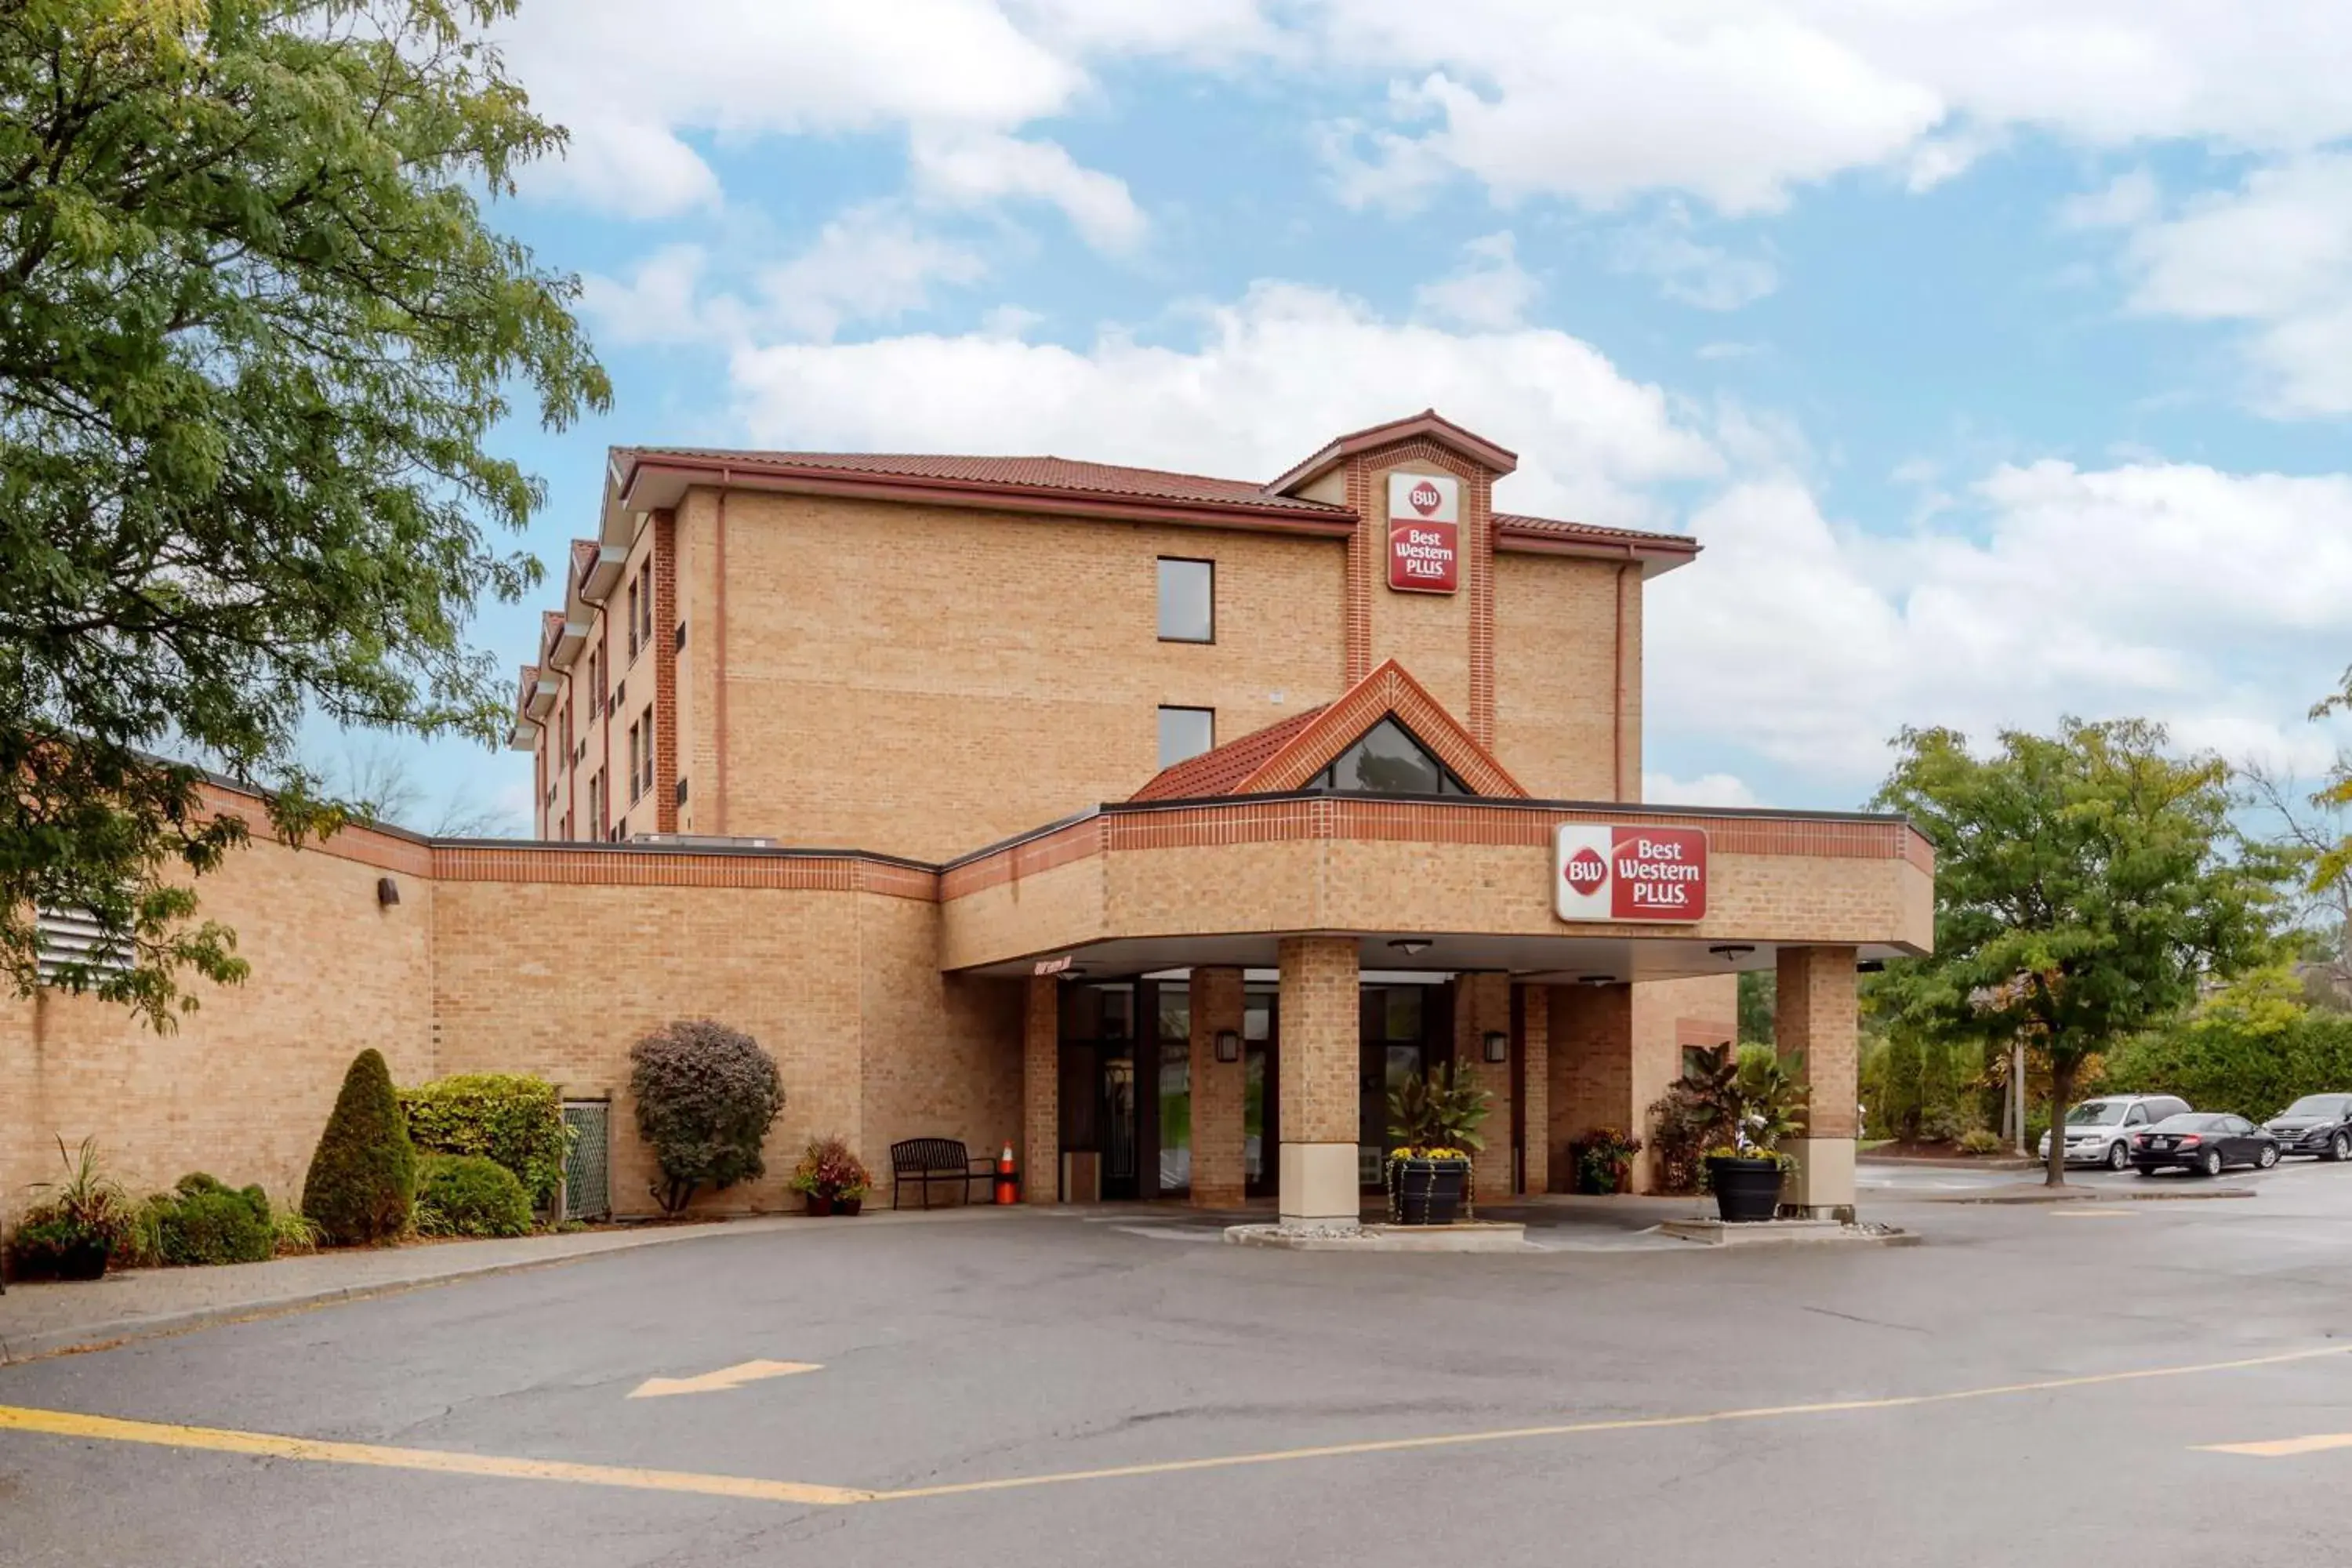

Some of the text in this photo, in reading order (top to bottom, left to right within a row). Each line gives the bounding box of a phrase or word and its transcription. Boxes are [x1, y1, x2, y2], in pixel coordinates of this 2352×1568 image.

[1412, 490, 1438, 506] BW
[1410, 529, 1442, 545] Best
[1396, 543, 1453, 561] Western
[1638, 840, 1682, 860] Best
[1570, 862, 1602, 881] BW
[1619, 858, 1700, 880] Western
